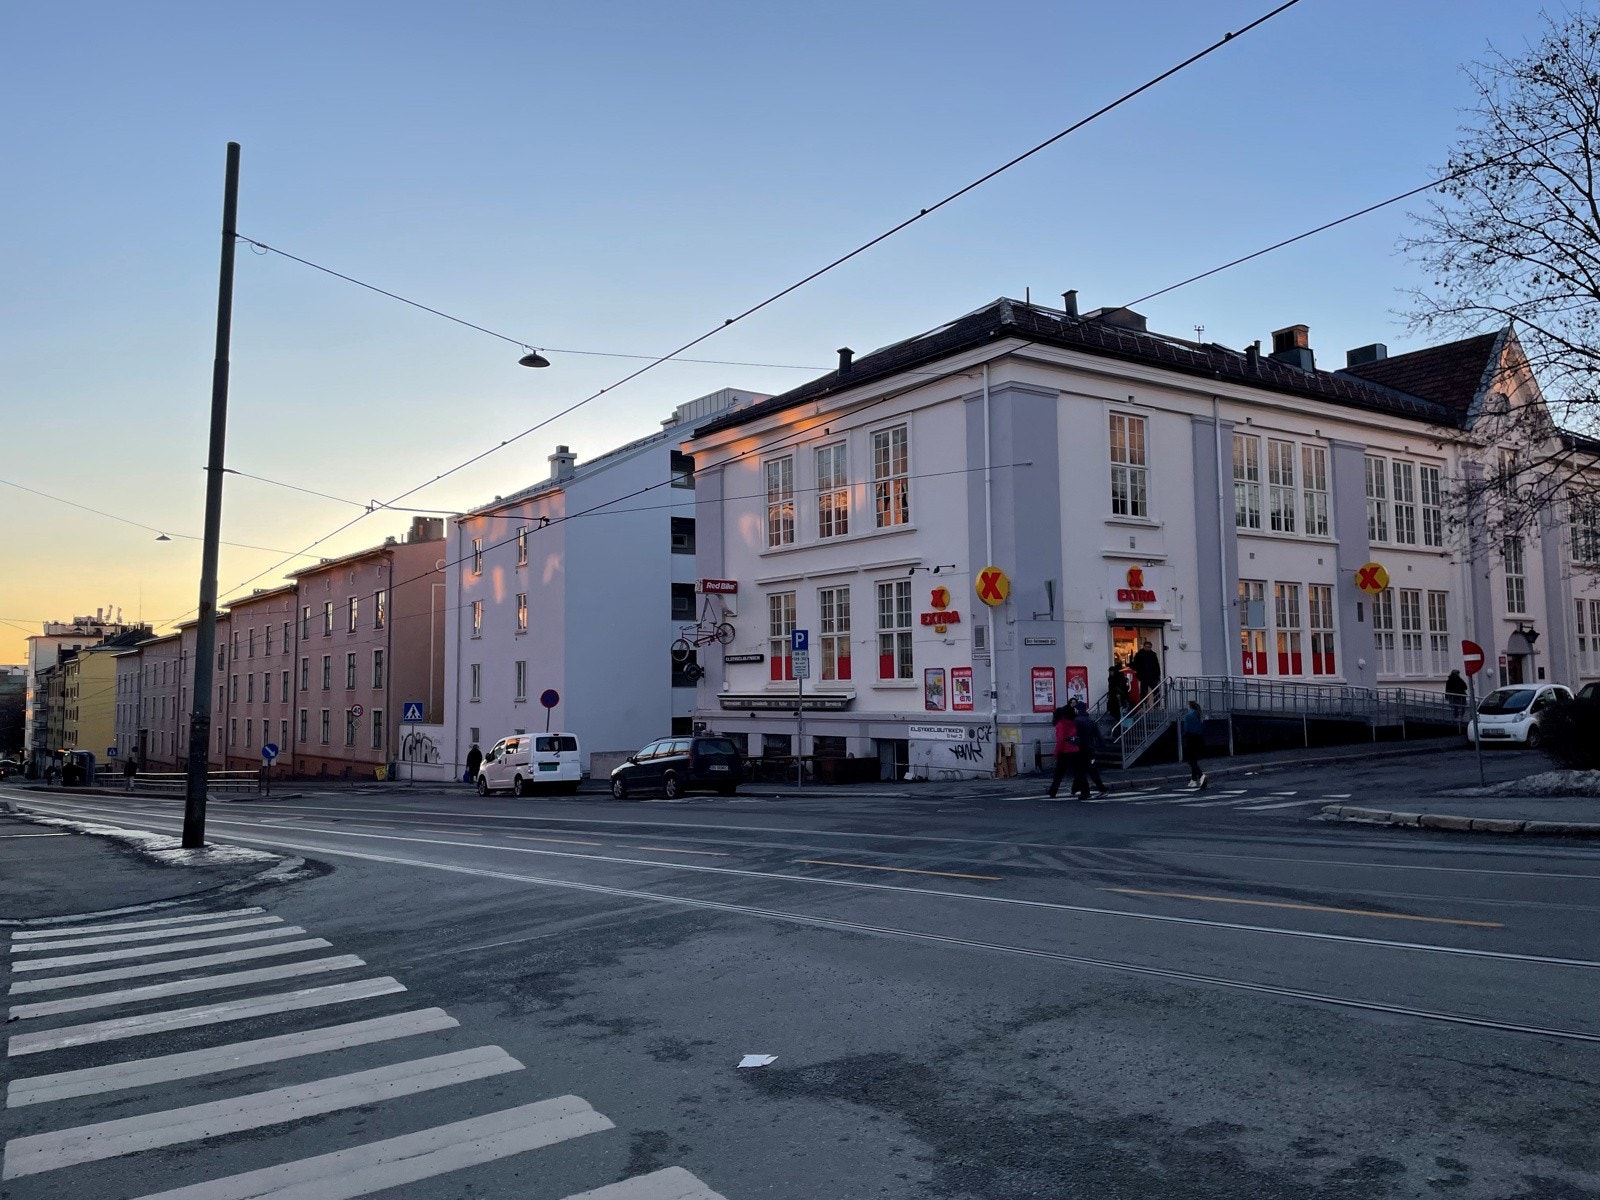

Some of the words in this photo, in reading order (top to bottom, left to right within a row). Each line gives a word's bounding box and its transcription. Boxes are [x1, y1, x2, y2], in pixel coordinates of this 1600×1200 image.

[706, 581, 720, 590] Red
[721, 582, 736, 591] Bike
[981, 571, 1004, 600] X
[1359, 567, 1383, 590] X
[930, 589, 946, 608] X
[1117, 589, 1157, 602] EXTRA
[921, 611, 961, 626] EXTRA
[795, 632, 805, 648] P
[910, 726, 964, 734] ELSYKKELBUTIKKEN
